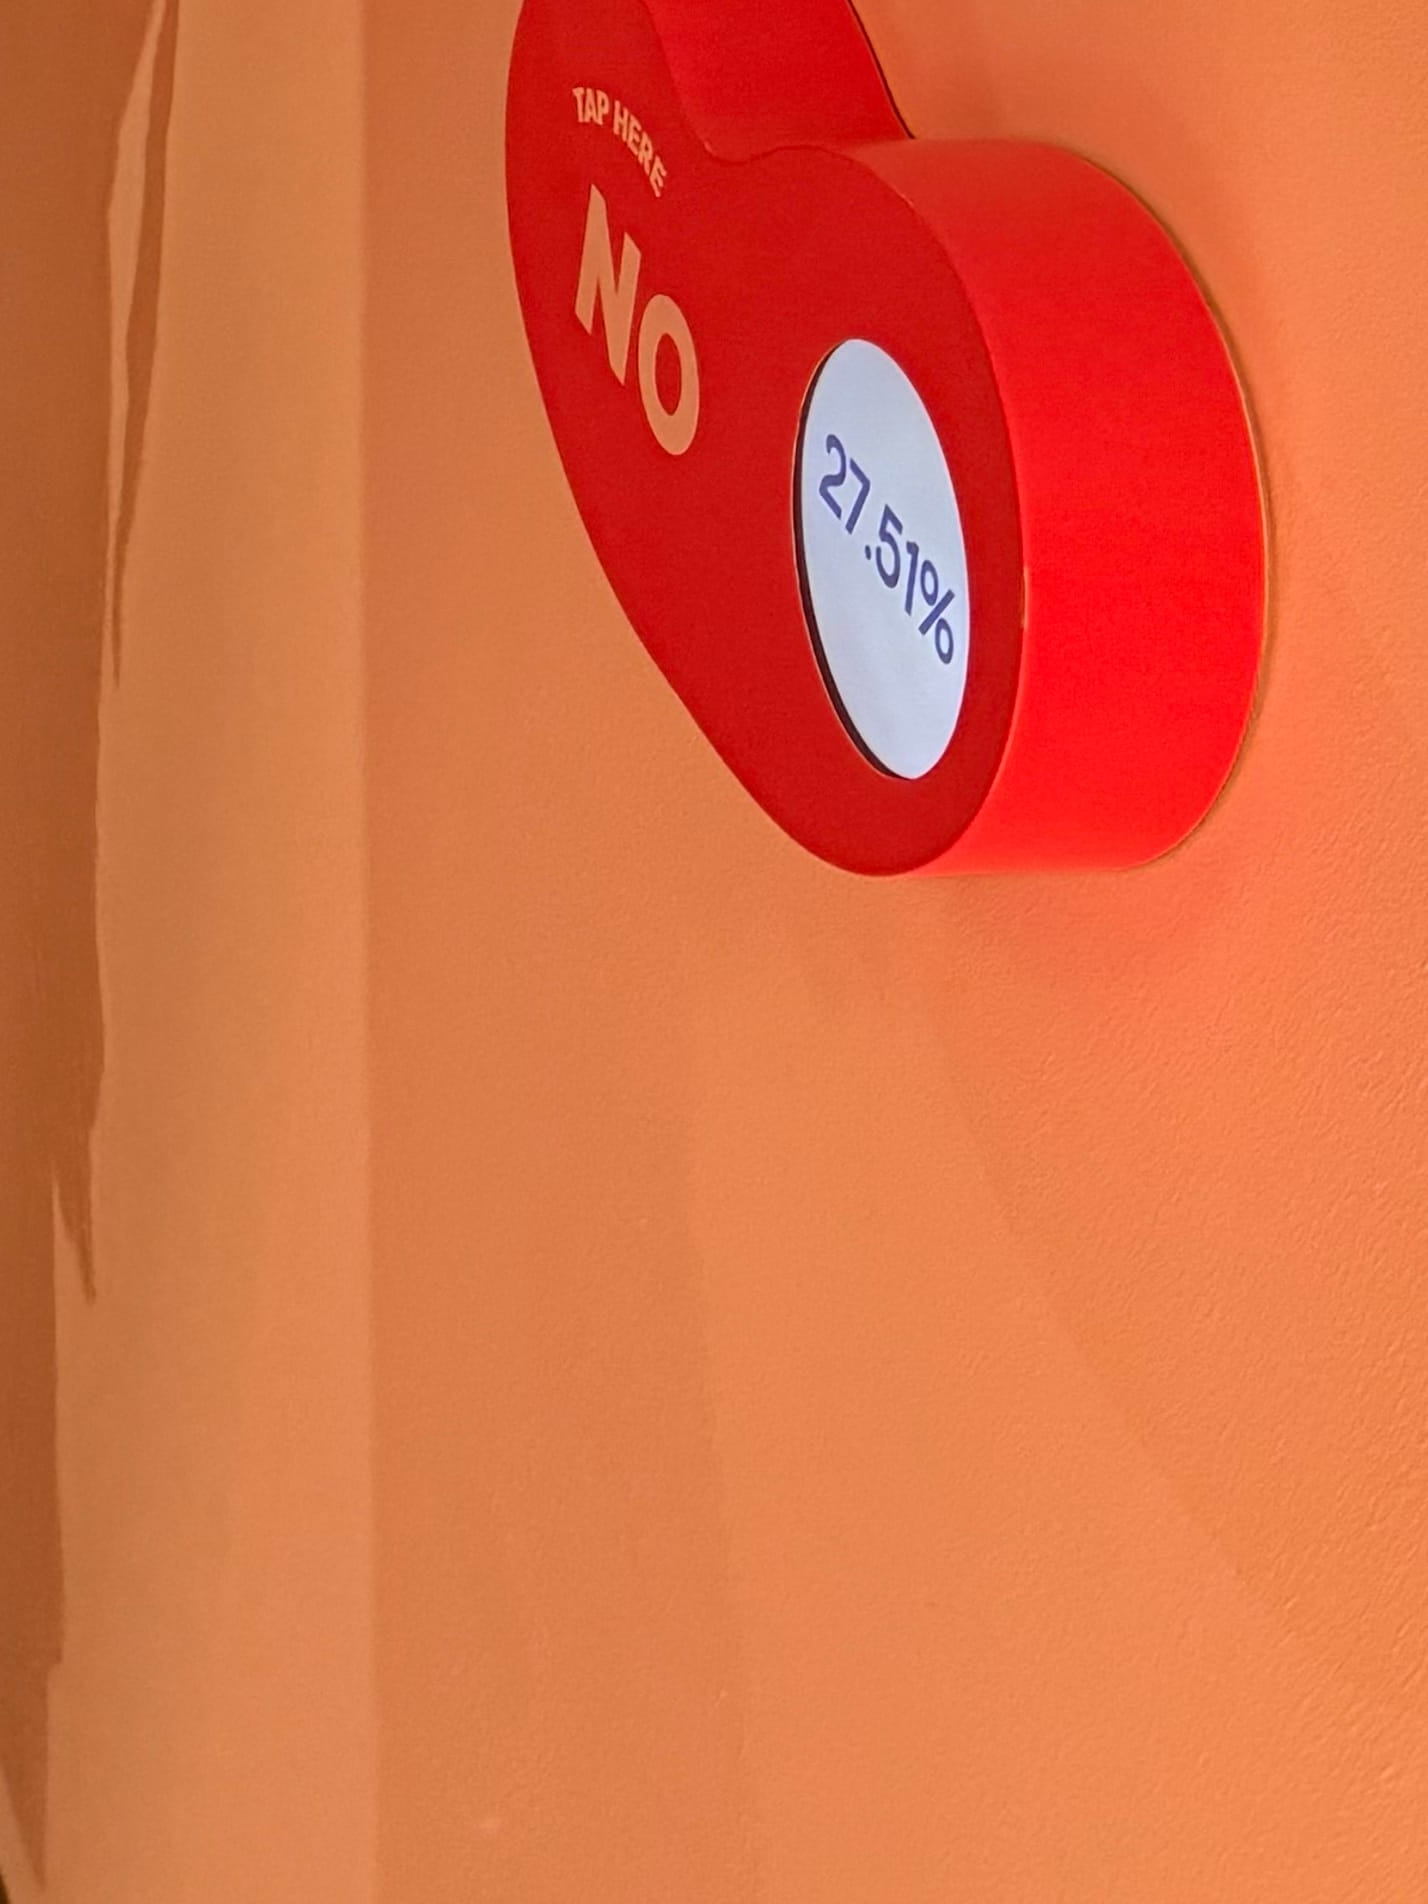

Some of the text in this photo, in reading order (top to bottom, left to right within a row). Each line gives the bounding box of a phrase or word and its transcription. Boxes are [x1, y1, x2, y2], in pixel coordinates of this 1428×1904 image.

[572, 87, 668, 198] TAP HERE
[574, 183, 701, 456] NO
[818, 433, 956, 666] 27.51%
